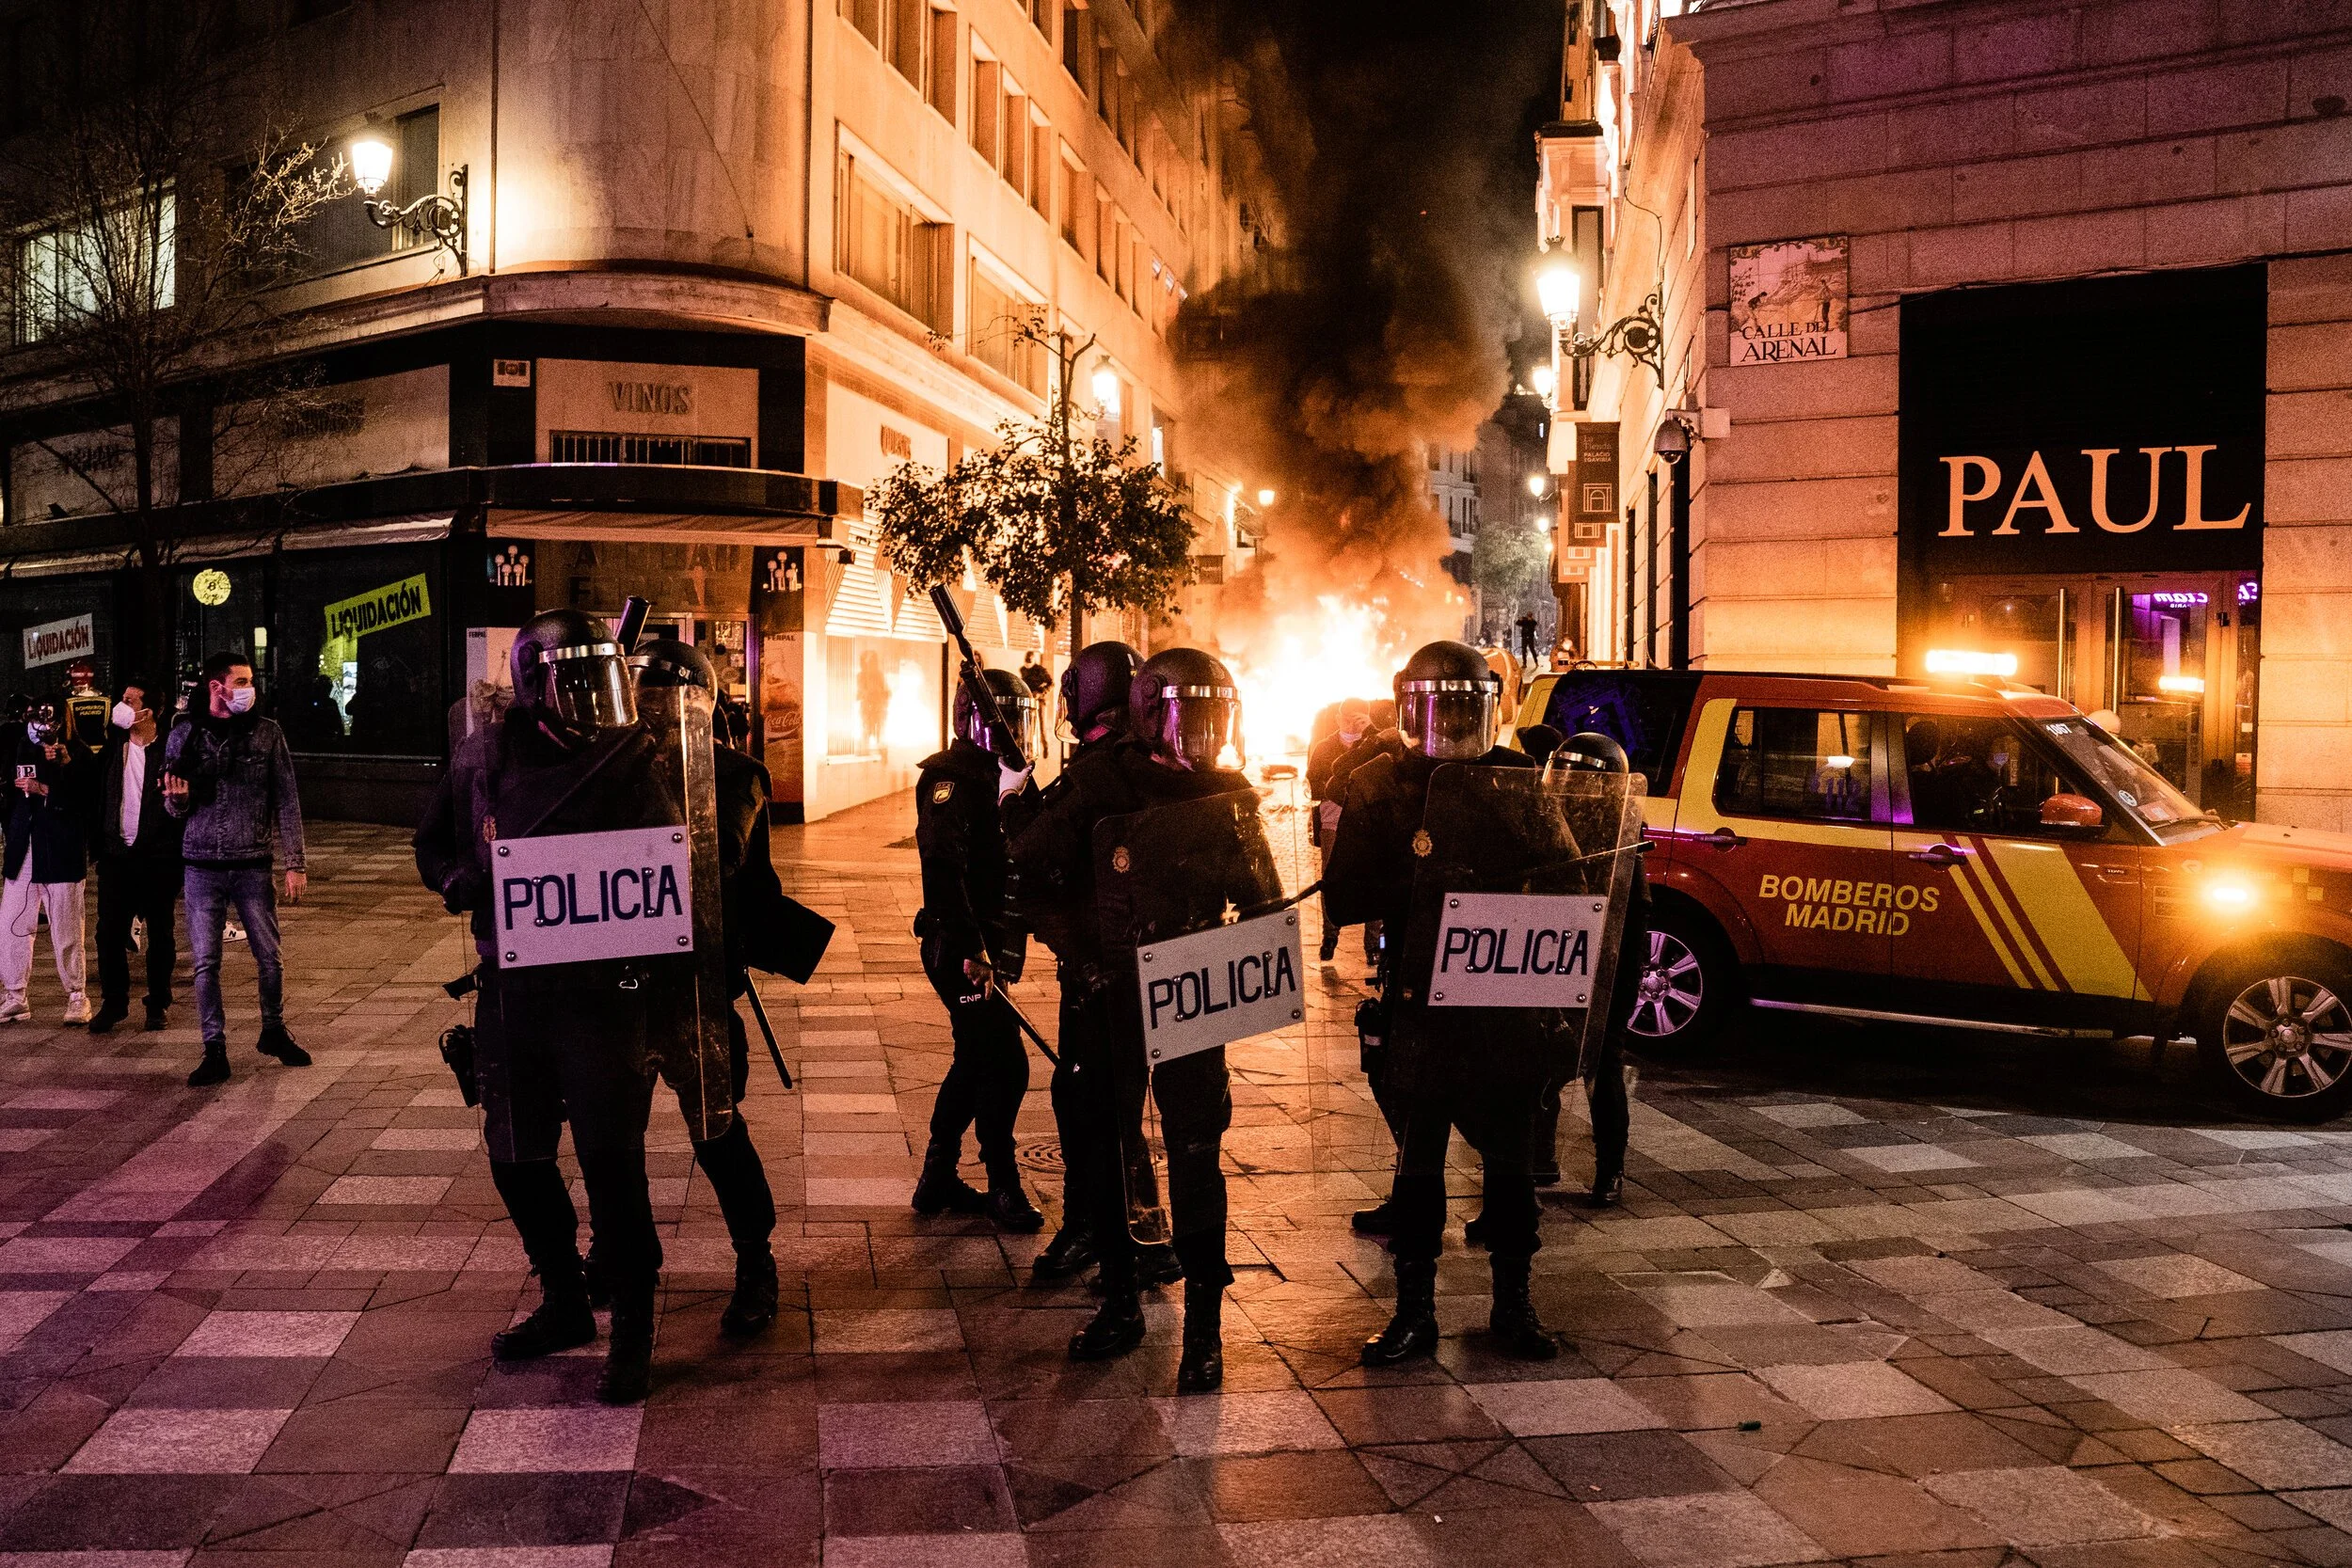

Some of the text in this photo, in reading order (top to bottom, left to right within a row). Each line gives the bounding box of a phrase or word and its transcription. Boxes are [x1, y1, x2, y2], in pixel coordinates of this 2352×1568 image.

[1740, 337, 1836, 363] ARENAL
[1742, 321, 1835, 340] CALLE DEL
[609, 381, 692, 415] VINOS
[1938, 444, 2252, 537] PAUL
[331, 582, 422, 640] LIQUIDACIÓN
[27, 620, 89, 661] LIQUIDACIÓN
[503, 864, 683, 930] POLICIA
[1759, 875, 1941, 913] BOMBEROS
[1785, 902, 1910, 936] MADRID
[1440, 926, 1589, 977] POLICIA
[958, 992, 983, 1005] CNP
[1148, 945, 1297, 1030] POLICIA
